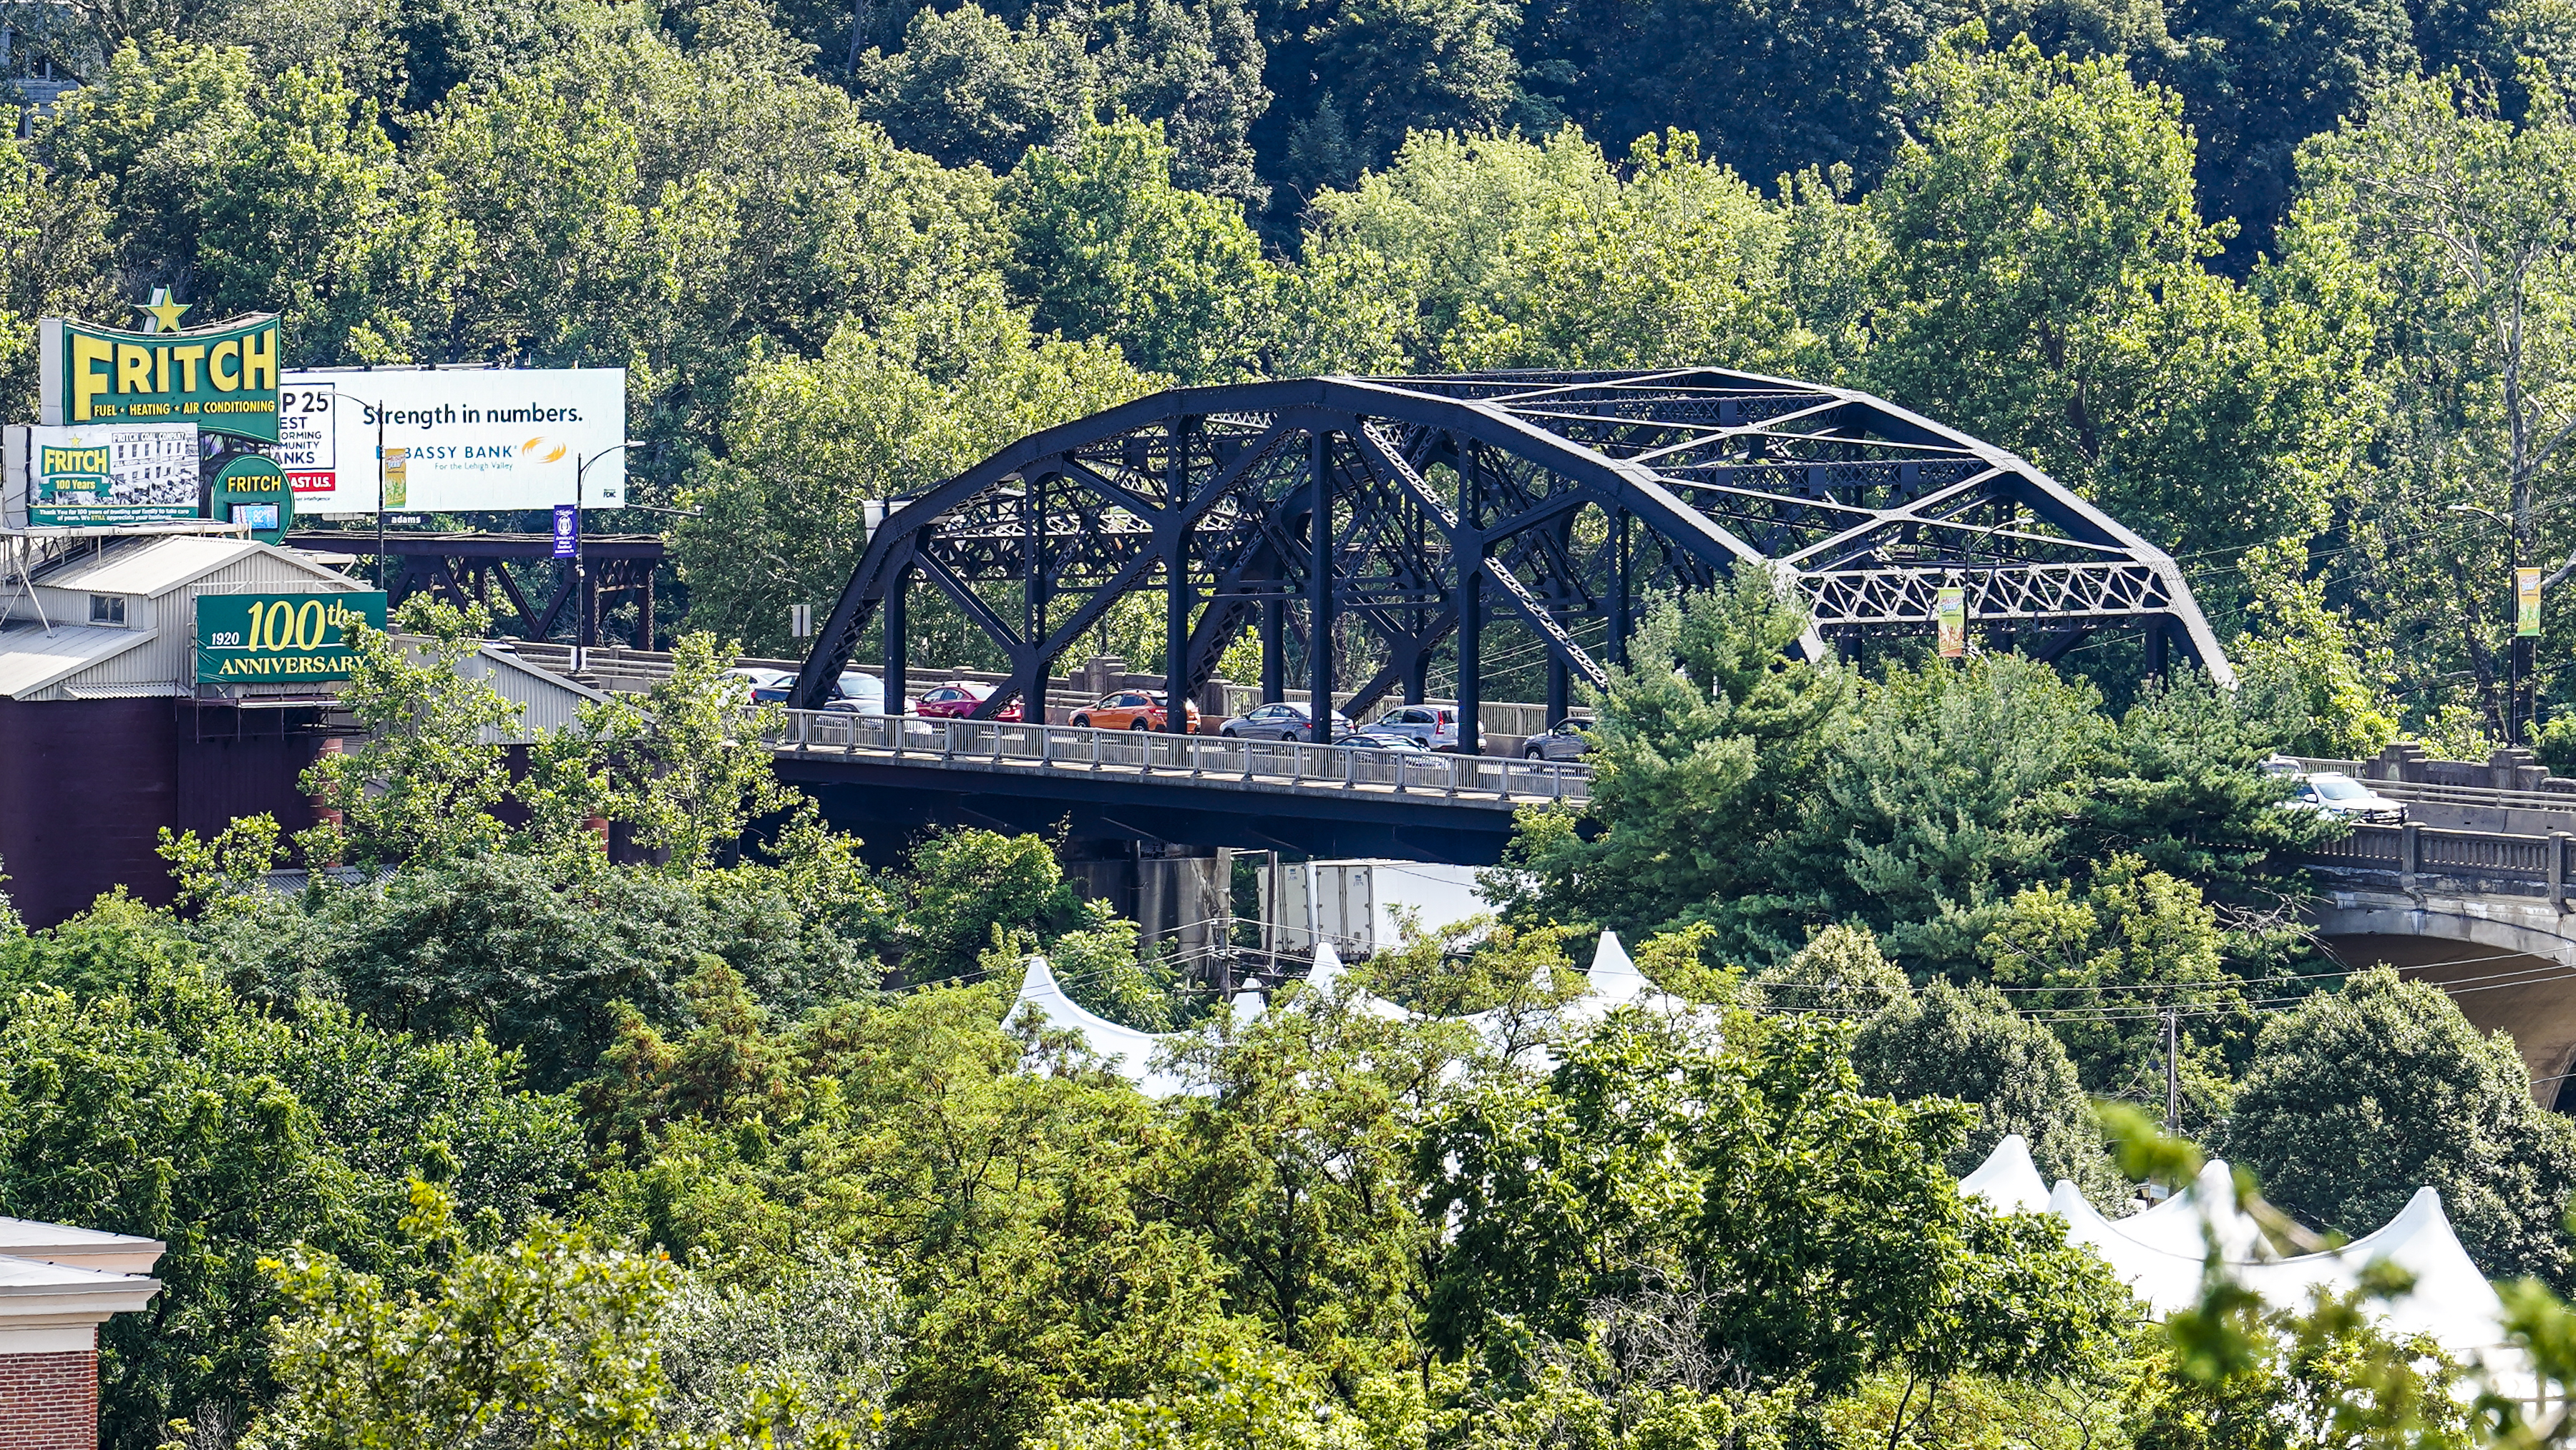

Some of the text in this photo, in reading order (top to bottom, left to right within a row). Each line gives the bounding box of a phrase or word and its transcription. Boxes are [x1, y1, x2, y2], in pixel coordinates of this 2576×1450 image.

[74, 328, 276, 421] FRITCH
[302, 391, 328, 413] 25
[94, 404, 117, 417] FUEL
[130, 403, 171, 416] HEATING
[183, 402, 200, 415] AIR
[204, 401, 275, 413] CONDITIONING
[462, 403, 480, 423] in
[487, 402, 583, 423] numbers.
[279, 416, 308, 429] EST
[112, 432, 185, 443] FRITCH COAL COMPANY
[281, 431, 322, 440] ORMING
[282, 441, 320, 449] MUNITY
[274, 451, 315, 464] ANKS
[376, 446, 457, 459] BASSY
[465, 445, 512, 459] BANK
[44, 449, 107, 474] FRITCH
[464, 462, 489, 471] Lehigh
[491, 461, 513, 471] Valley
[55, 479, 96, 490] 100 Years
[228, 475, 281, 493] FRITCH
[291, 476, 332, 488] AST U.S.
[391, 515, 421, 524] adams
[248, 599, 350, 652] 100th
[212, 632, 240, 645] 1920
[219, 655, 368, 675] ANNIVERSARY
